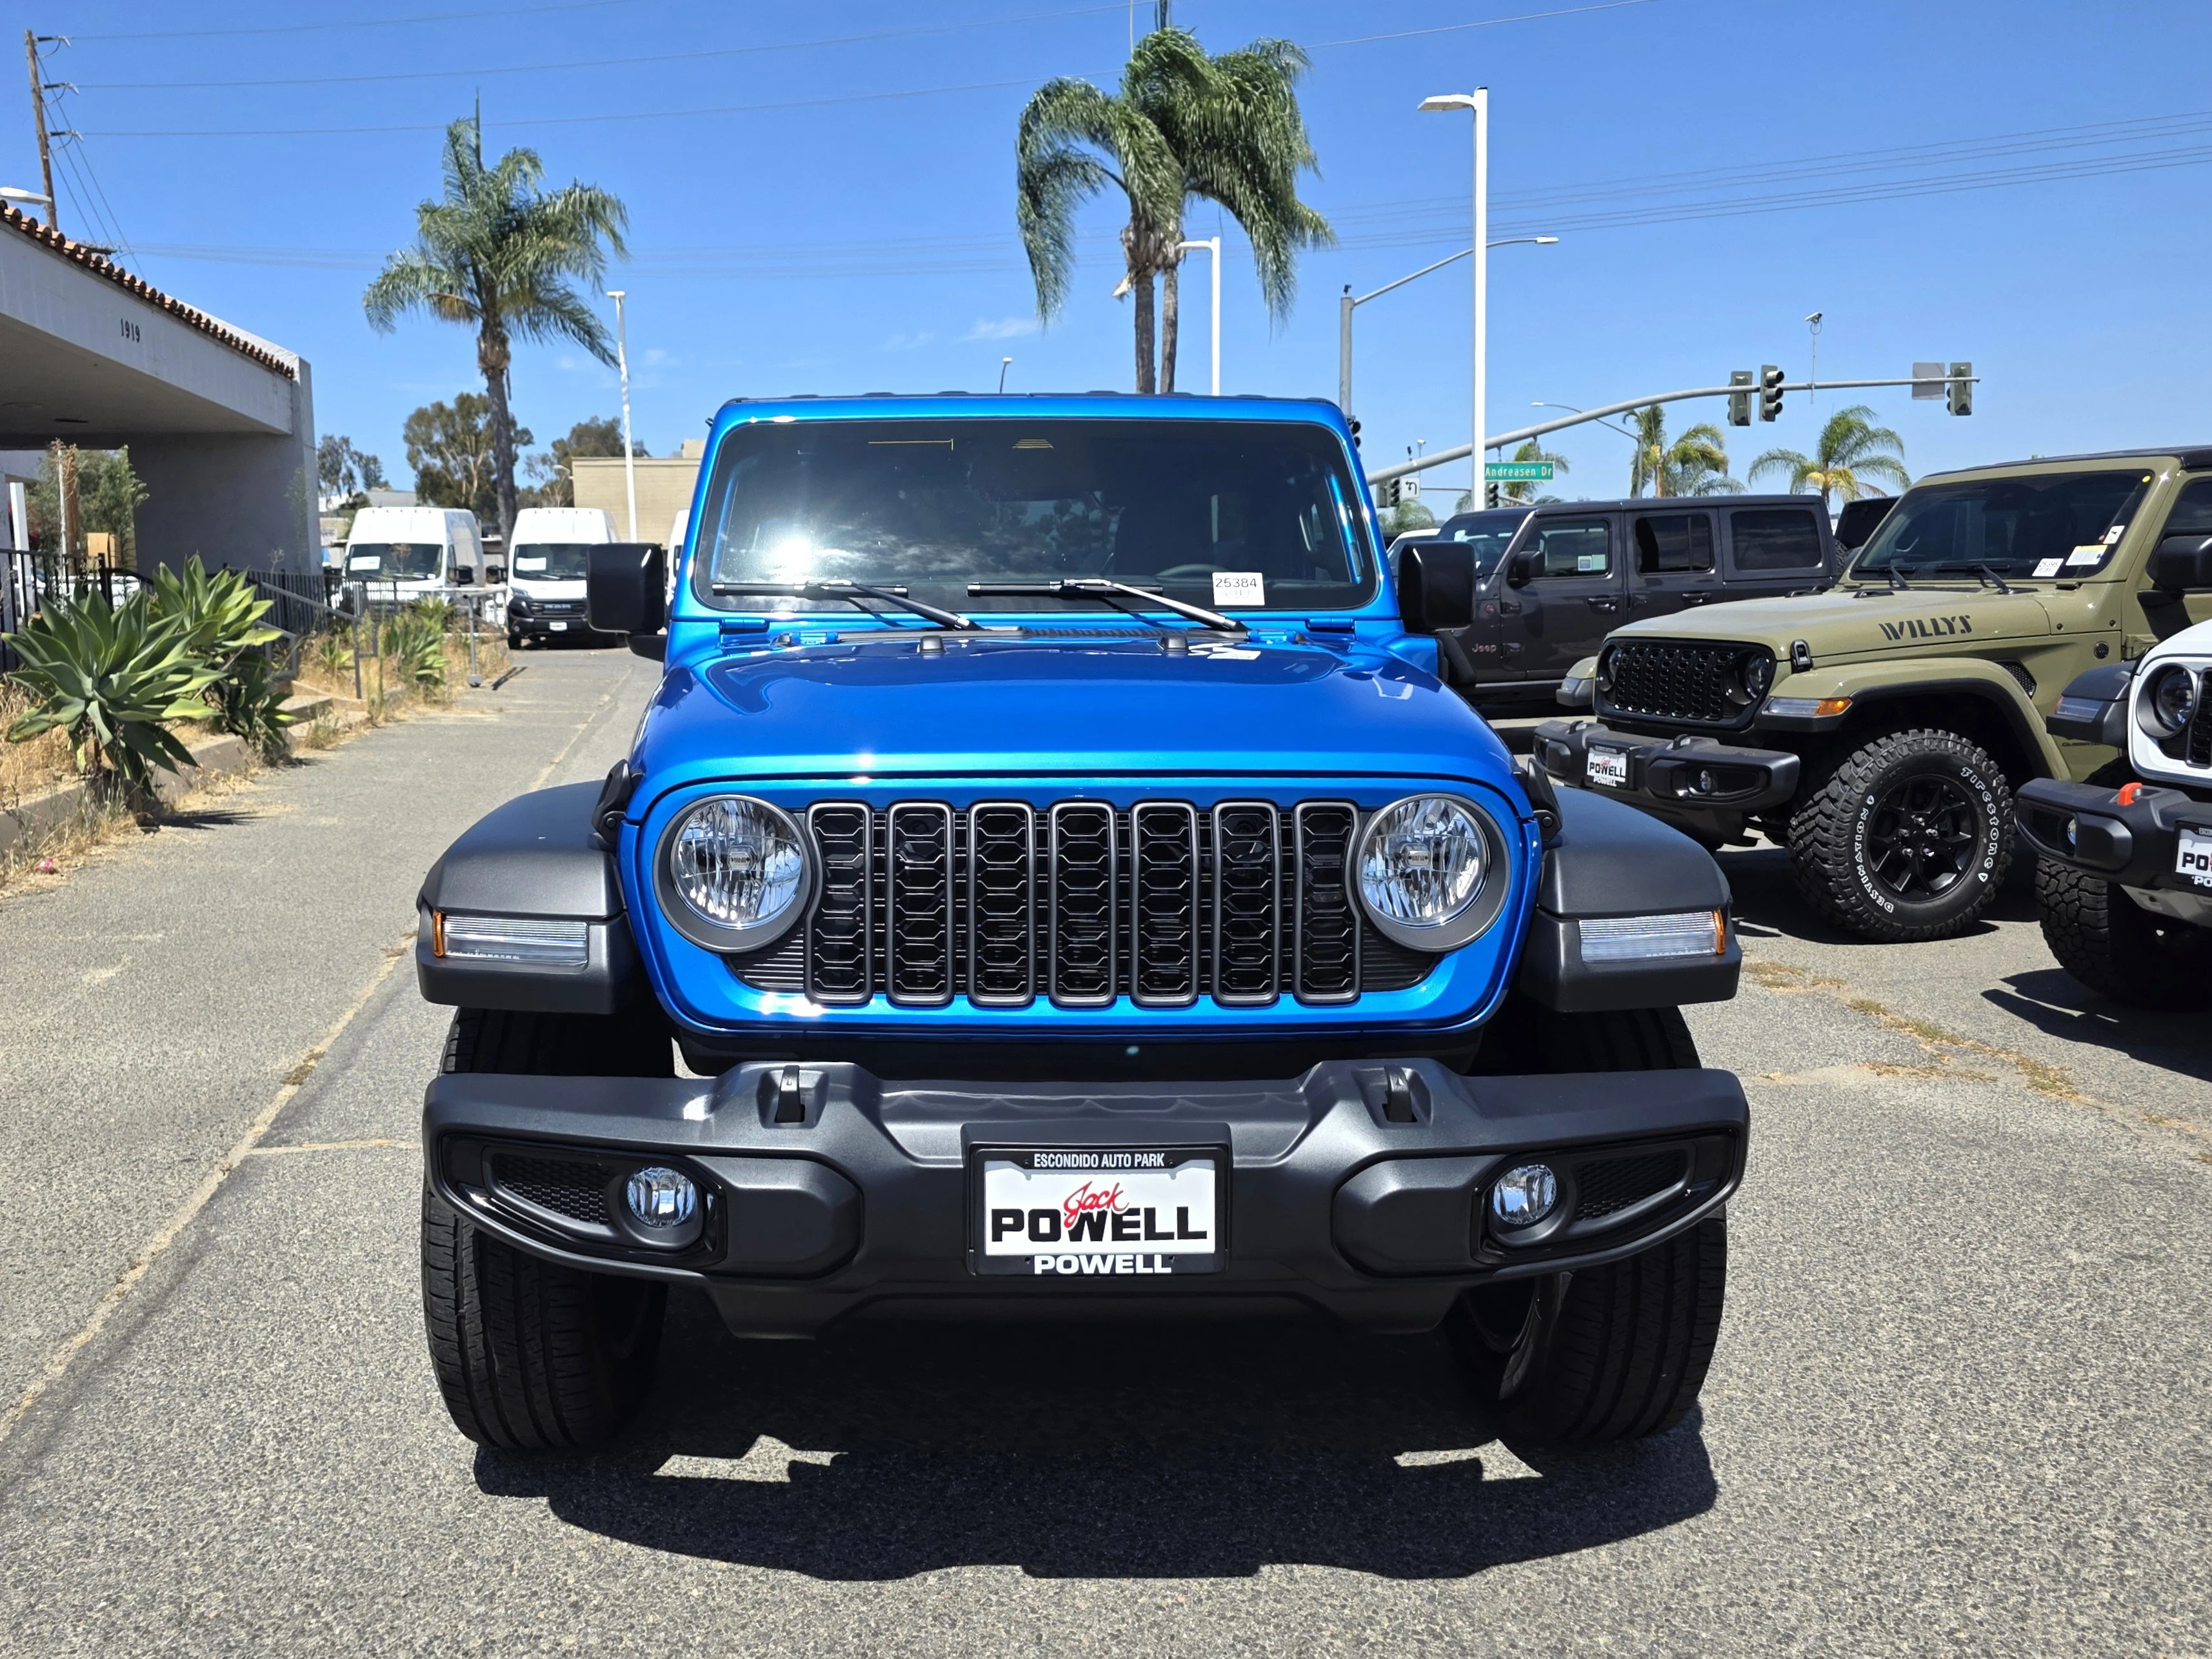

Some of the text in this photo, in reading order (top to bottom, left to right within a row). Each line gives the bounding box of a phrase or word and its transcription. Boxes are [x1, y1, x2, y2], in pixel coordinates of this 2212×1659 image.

[121, 317, 141, 343] 1919
[1485, 466, 1552, 477] Andreasen Dr
[1215, 578, 1257, 588] 25384
[1878, 615, 1973, 641] WILLYS
[1472, 643, 1497, 654] Jeep
[1589, 761, 1626, 778] POWELL
[1593, 776, 1617, 787] POWELL
[1855, 808, 1895, 914] DESTINATION
[2182, 851, 2212, 872] PO
[1034, 1153, 1165, 1168] ESCONDIDO AUTO PARK
[1063, 1180, 1130, 1229] Jack
[991, 1206, 1208, 1242] POWELL
[1034, 1254, 1172, 1274] POWELL
